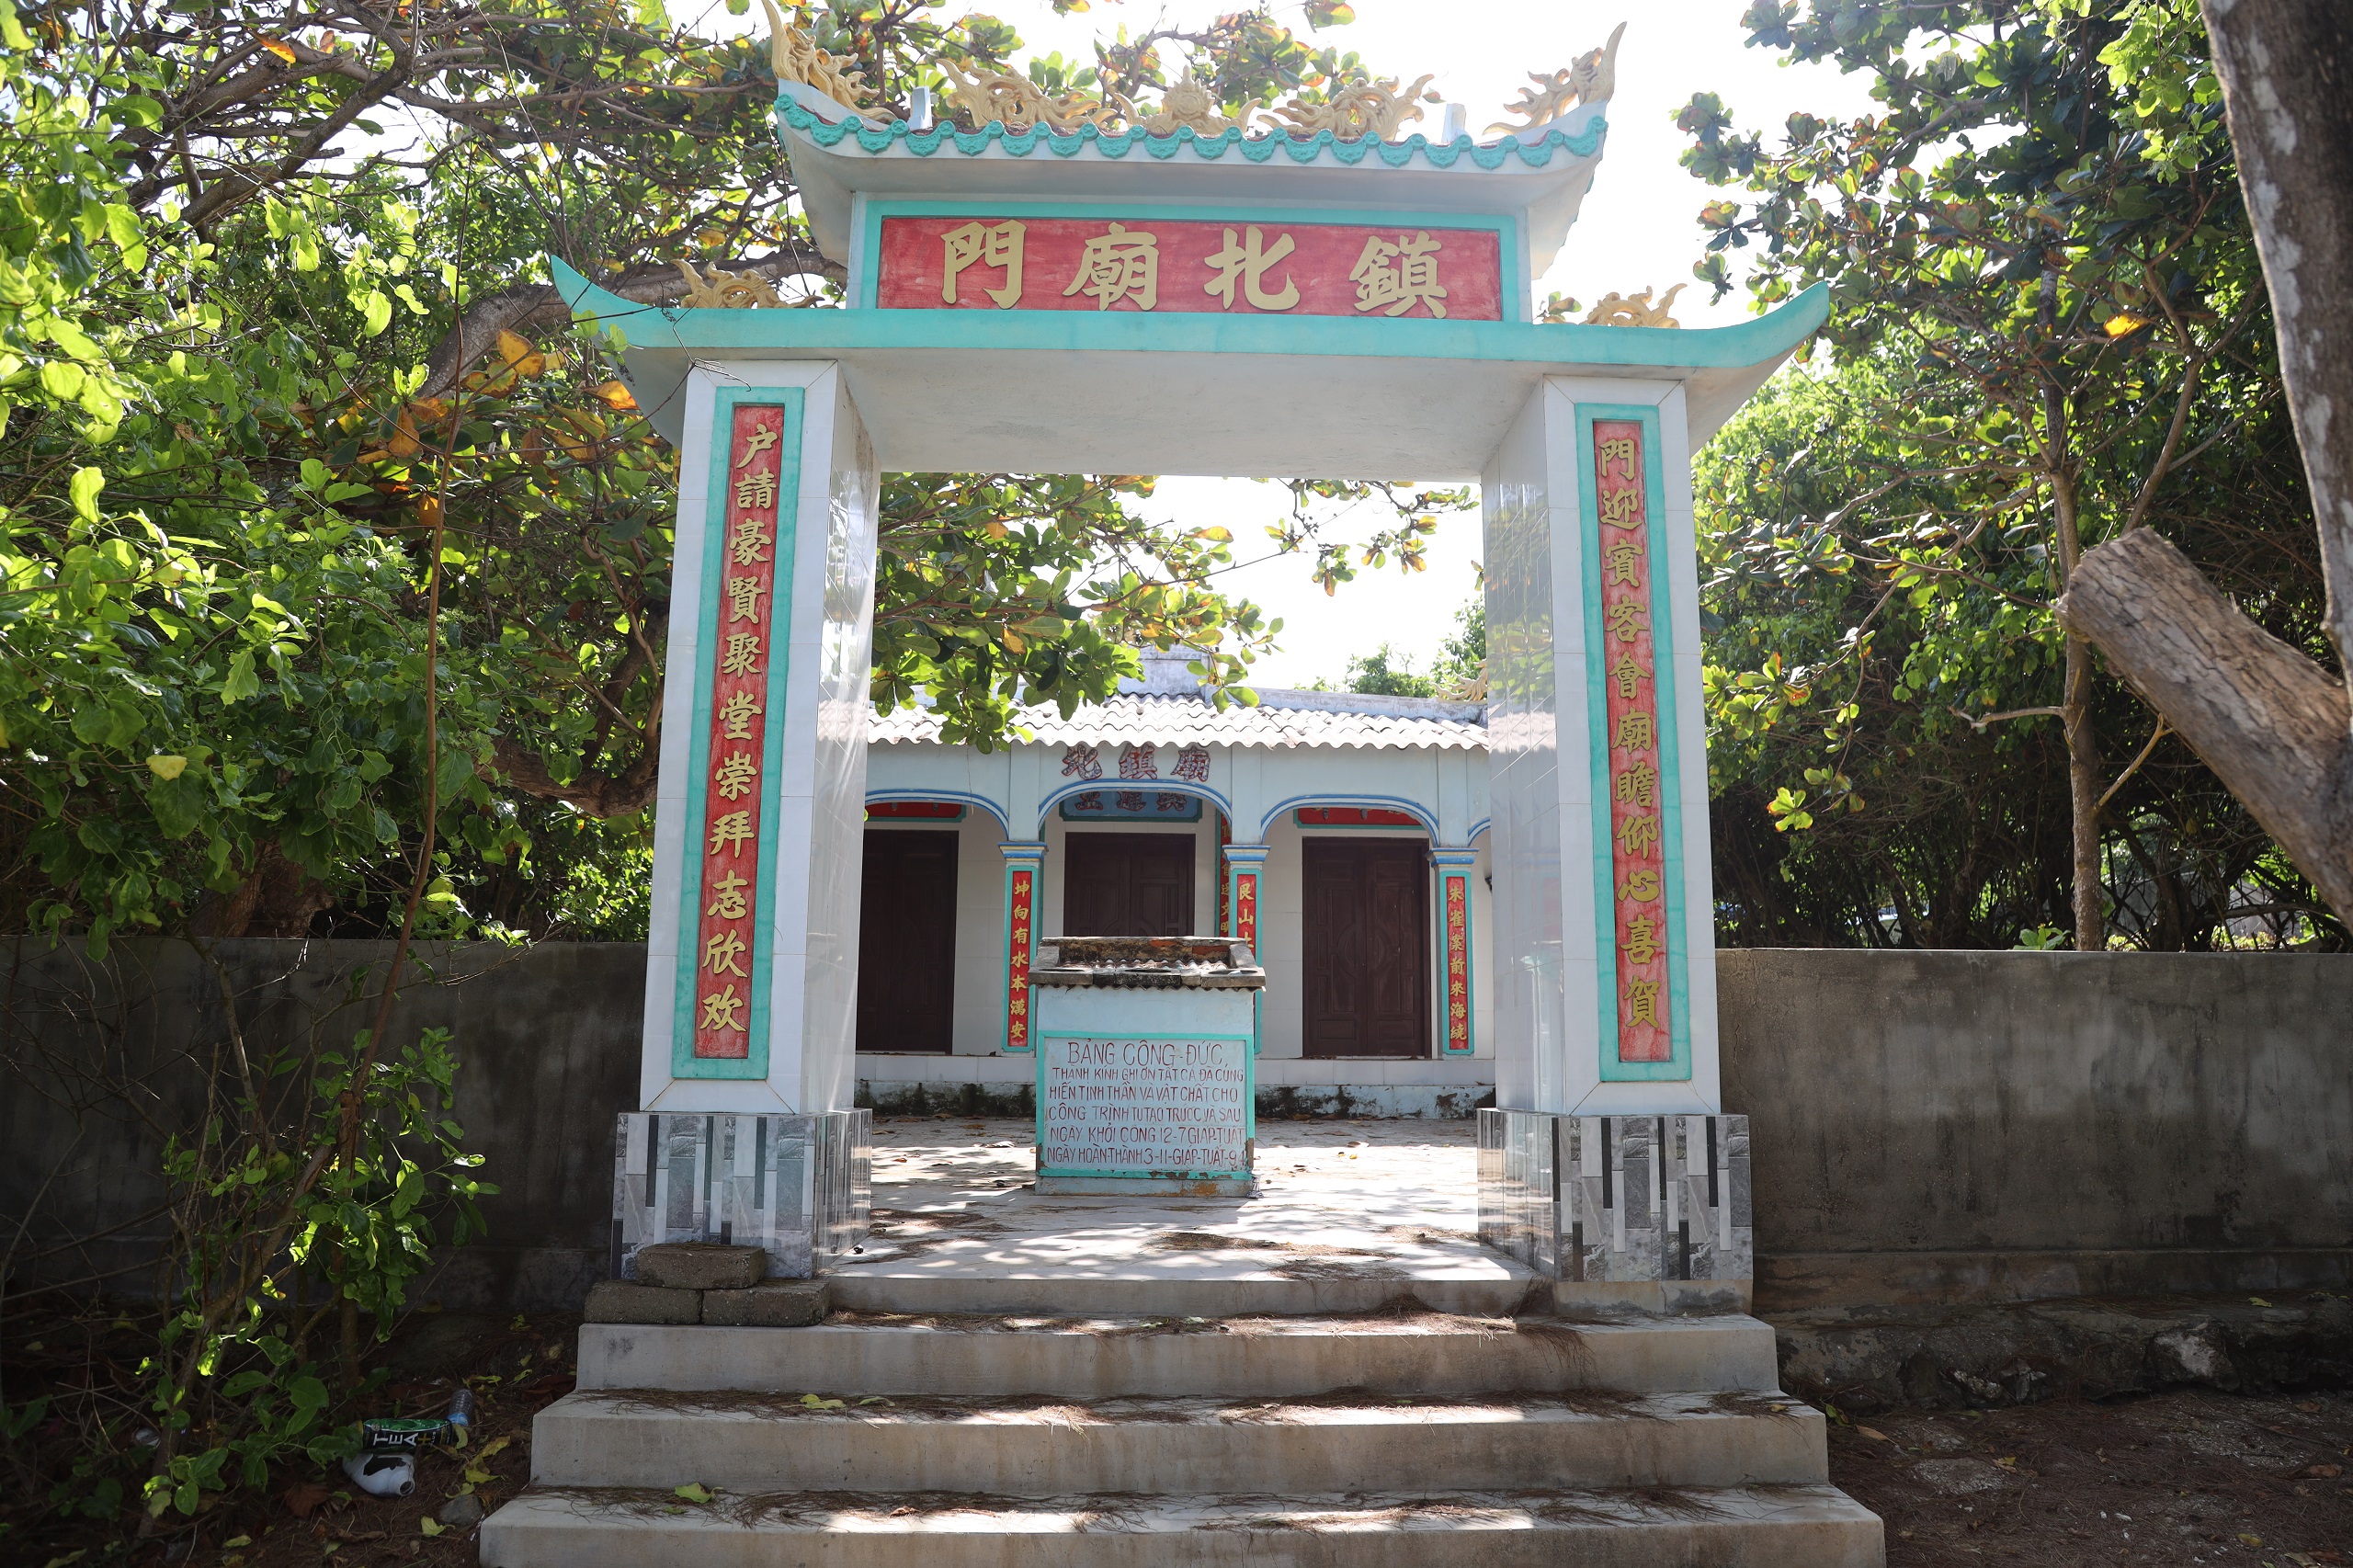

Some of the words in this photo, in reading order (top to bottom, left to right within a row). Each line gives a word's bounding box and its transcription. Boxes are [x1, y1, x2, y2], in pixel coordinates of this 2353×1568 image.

[1067, 1038, 1115, 1065] BẢNG
[1052, 1064, 1089, 1081] THÀNH
[1094, 1064, 1119, 1081] KÍNH
[1121, 1067, 1138, 1081] GHI
[1199, 1065, 1213, 1082] ĐÃ
[1215, 1063, 1244, 1082] CÚNG
[1049, 1081, 1076, 1100] HIẾN
[1107, 1081, 1137, 1101] THẦN
[1139, 1082, 1154, 1101] VÀ
[1180, 1082, 1210, 1103] CHẤT
[1211, 1087, 1238, 1103] CHO
[1049, 1102, 1086, 1121] CÔNG
[1092, 1102, 1130, 1121] TRÌNH
[1219, 1107, 1241, 1122] SAU
[1050, 1124, 1083, 1142] NGÀY
[1047, 1143, 1076, 1164] NGÀY
